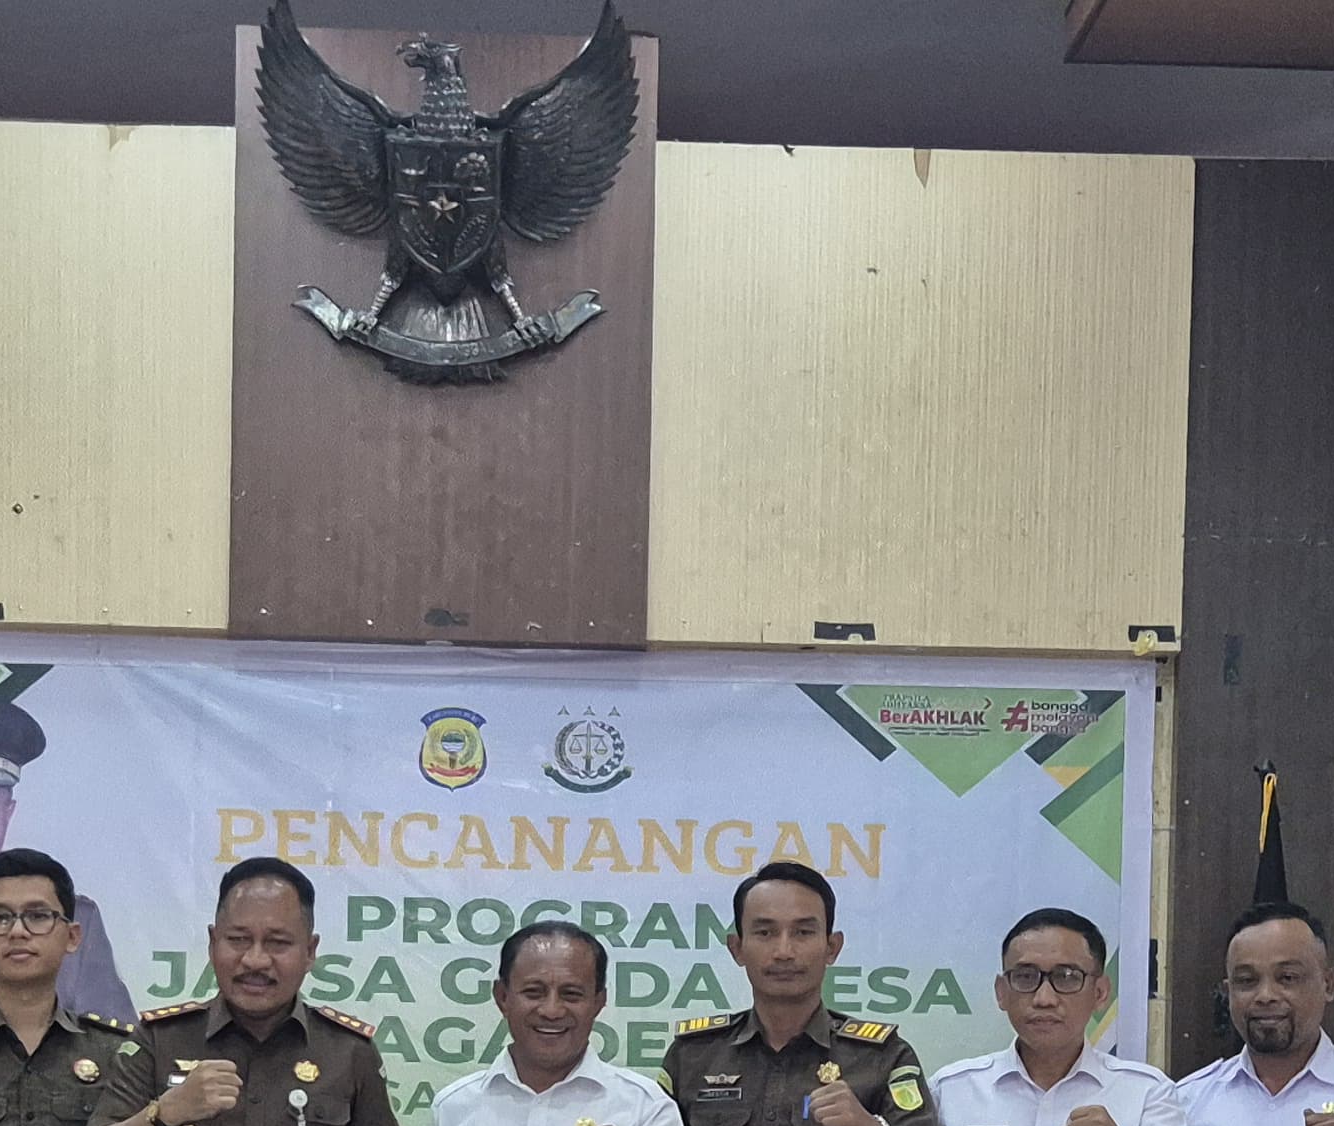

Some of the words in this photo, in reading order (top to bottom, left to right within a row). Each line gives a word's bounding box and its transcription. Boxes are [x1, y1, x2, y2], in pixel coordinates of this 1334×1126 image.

[880, 709, 986, 726] BerAKHLAK
[1031, 701, 1089, 713] bangga
[214, 808, 886, 879] PENCANANGAN
[147, 951, 415, 1003] JSA
[440, 957, 730, 1009] GDA
[822, 966, 972, 1015] ESA
